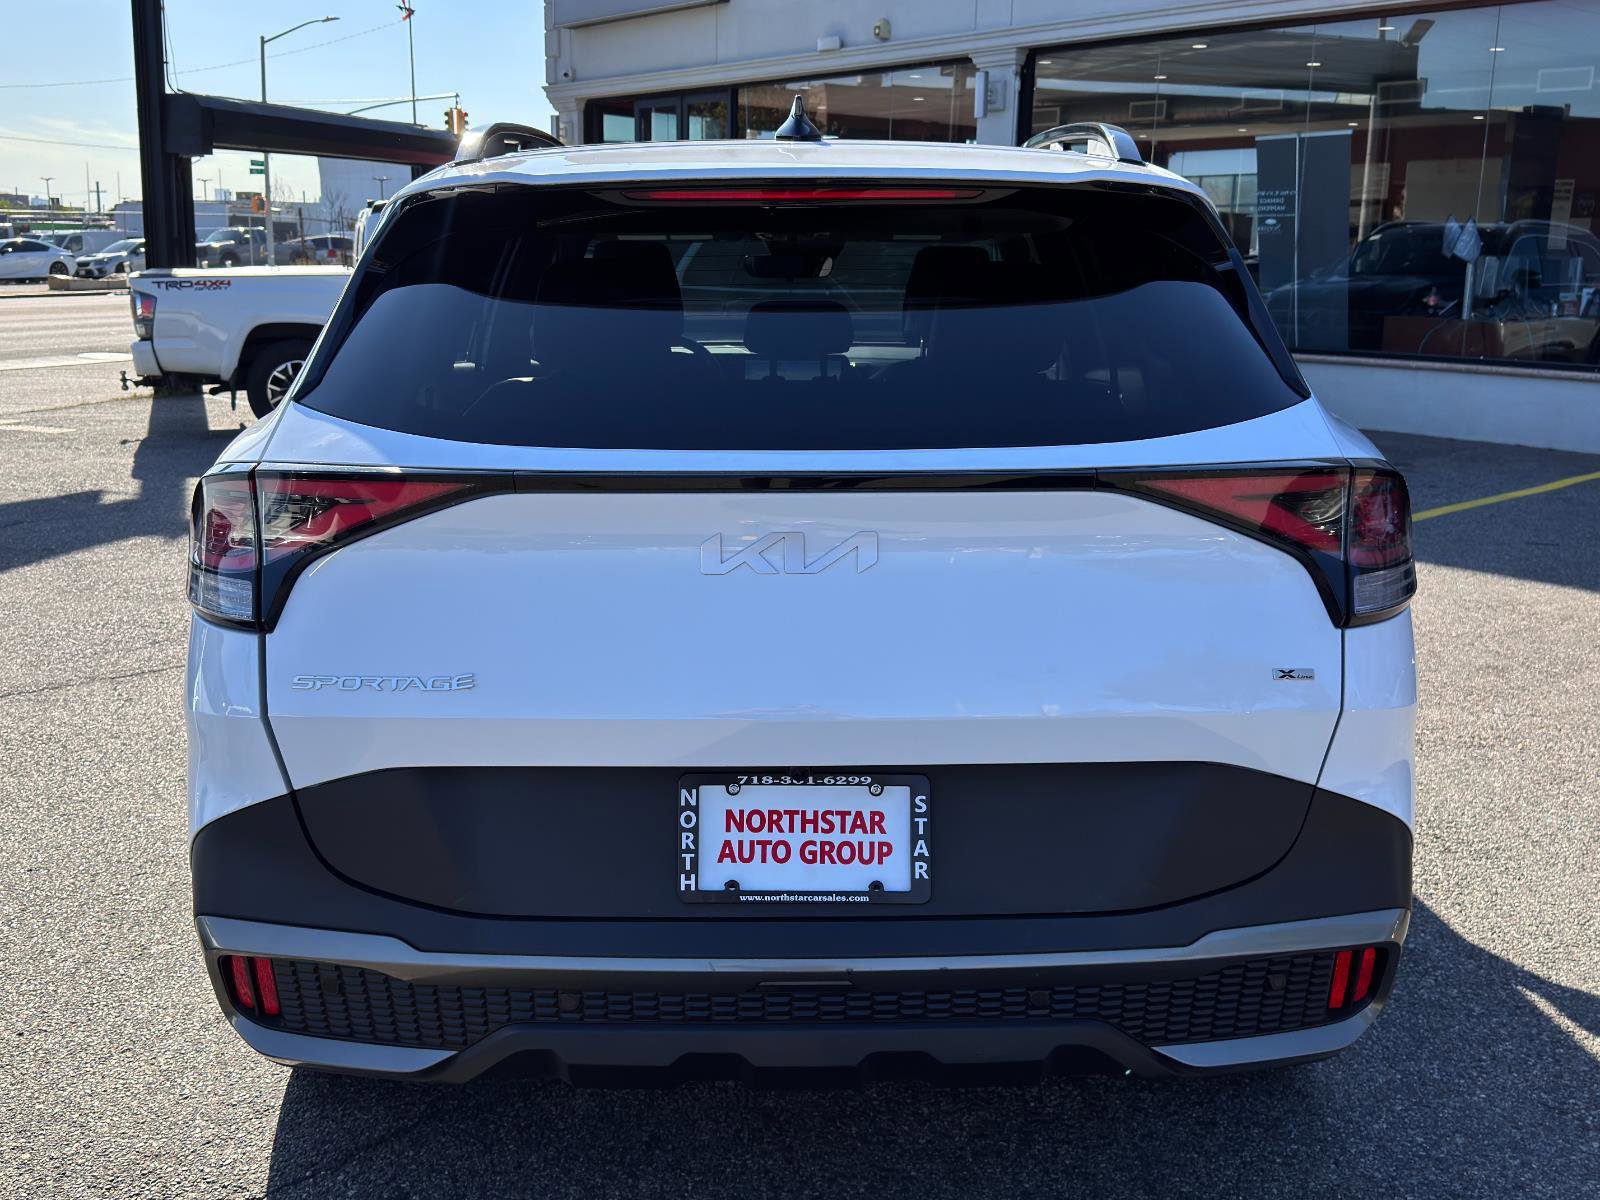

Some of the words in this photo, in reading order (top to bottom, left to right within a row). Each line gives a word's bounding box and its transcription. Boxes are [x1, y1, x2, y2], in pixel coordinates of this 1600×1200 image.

[700, 531, 879, 575] KIA
[292, 673, 476, 692] SPORTAGE
[725, 808, 888, 835] NORTHSTAR
[679, 788, 698, 892] NORTH
[913, 794, 931, 881] STAR
[717, 839, 792, 865] AUTO
[799, 840, 894, 866] GROUP
[739, 893, 870, 903] www.northstarcarsales.com
